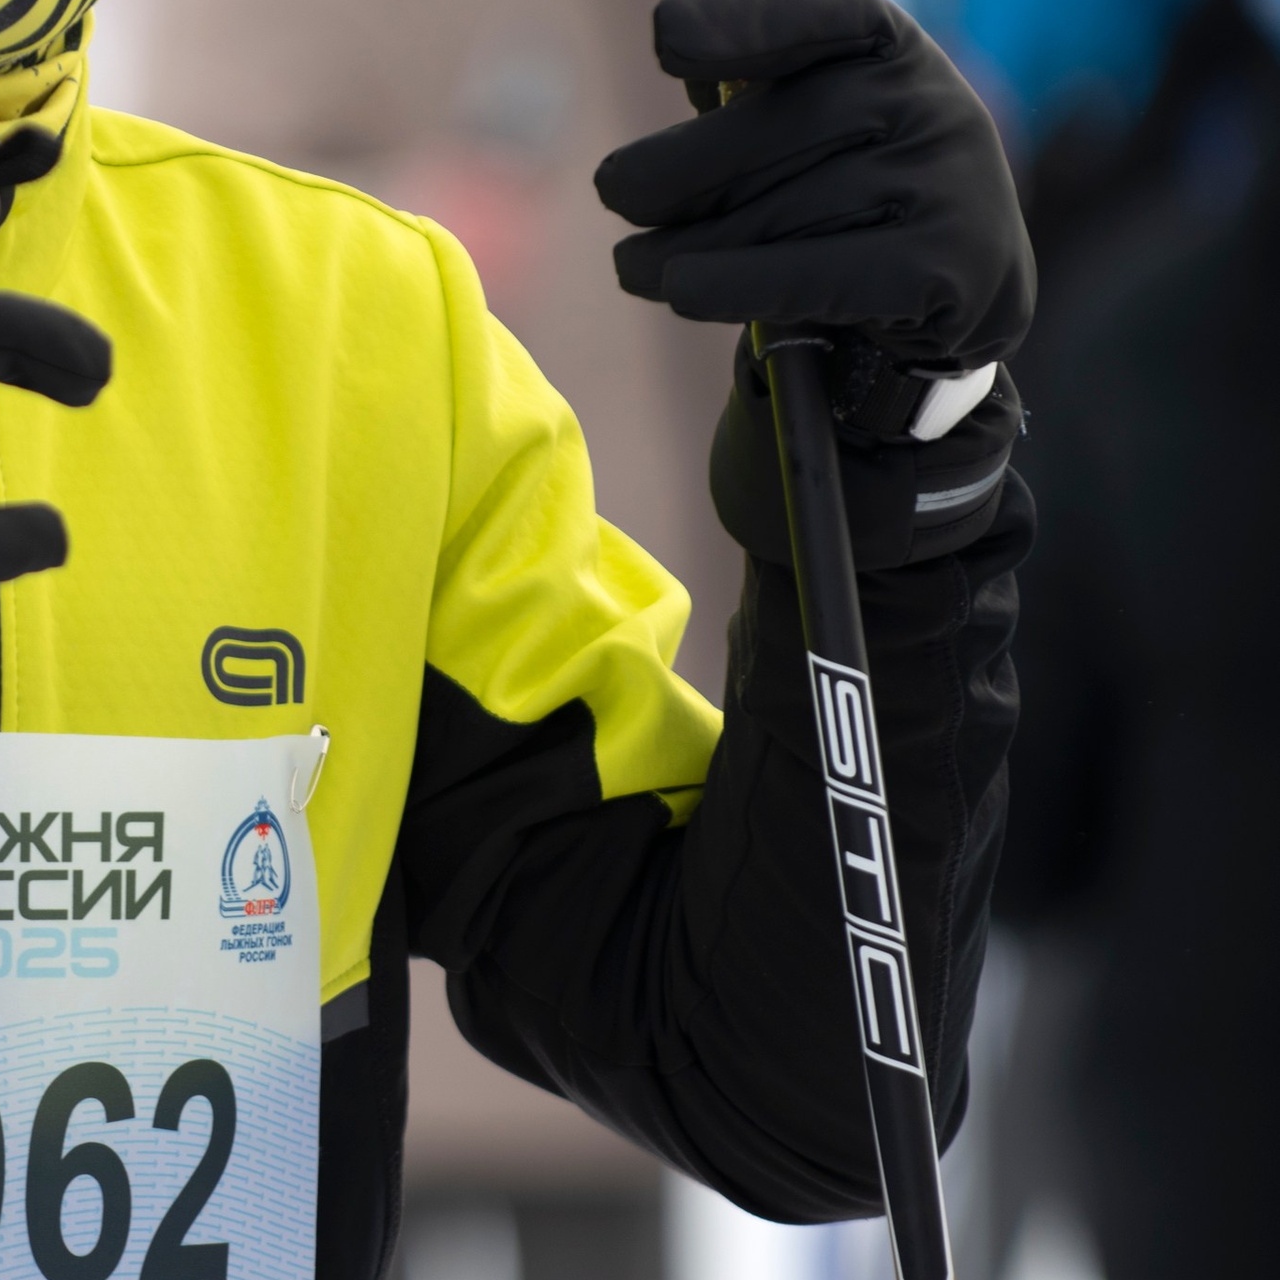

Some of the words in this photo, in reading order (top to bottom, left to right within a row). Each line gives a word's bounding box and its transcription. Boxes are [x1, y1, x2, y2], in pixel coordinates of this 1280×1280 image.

[813, 662, 917, 1064] STC
[232, 922, 285, 935] ФЕДЕРАЦИЯ
[221, 938, 264, 950] ЛЫЖНЫХ
[266, 935, 292, 947] ГОНОК
[240, 951, 276, 963] РОССИИ
